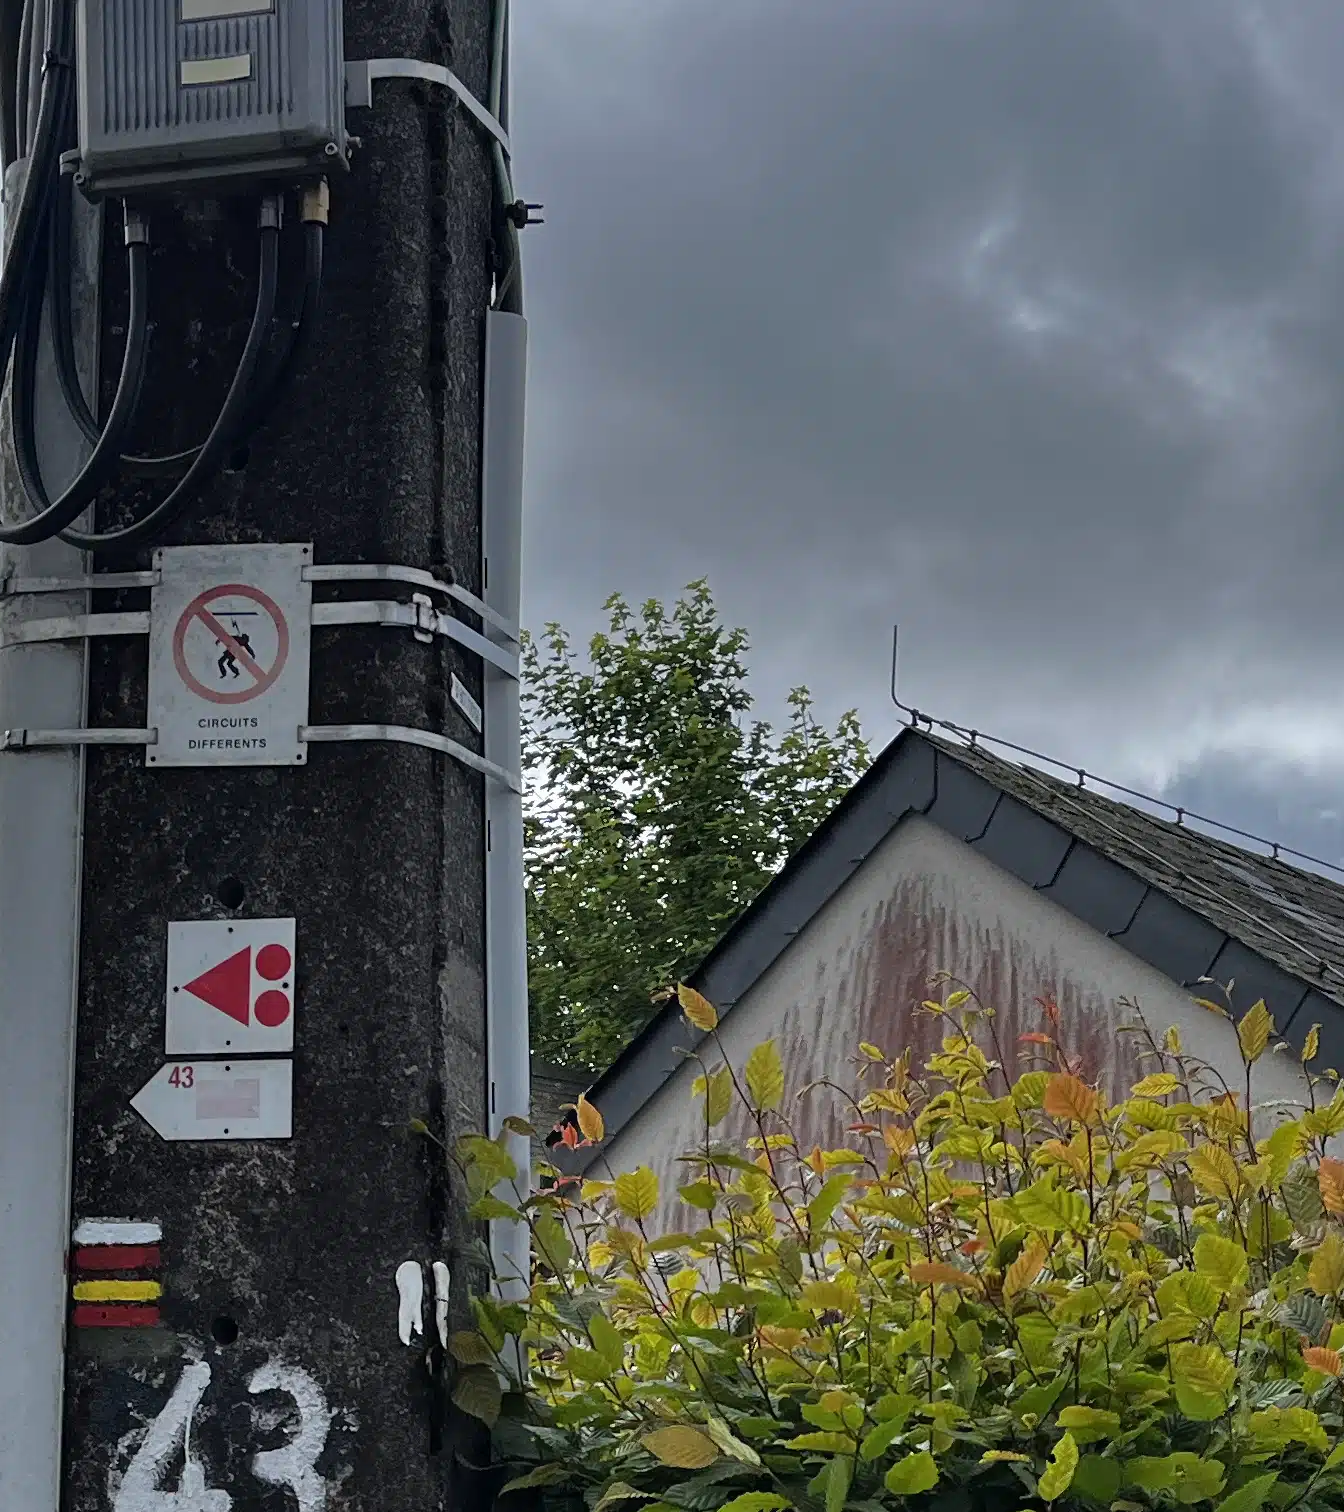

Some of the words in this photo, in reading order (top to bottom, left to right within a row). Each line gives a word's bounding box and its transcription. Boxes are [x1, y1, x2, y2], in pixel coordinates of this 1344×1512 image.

[198, 717, 258, 728] CIRCUITS
[188, 738, 267, 749] DIFFERENTS
[168, 1066, 194, 1089] 43
